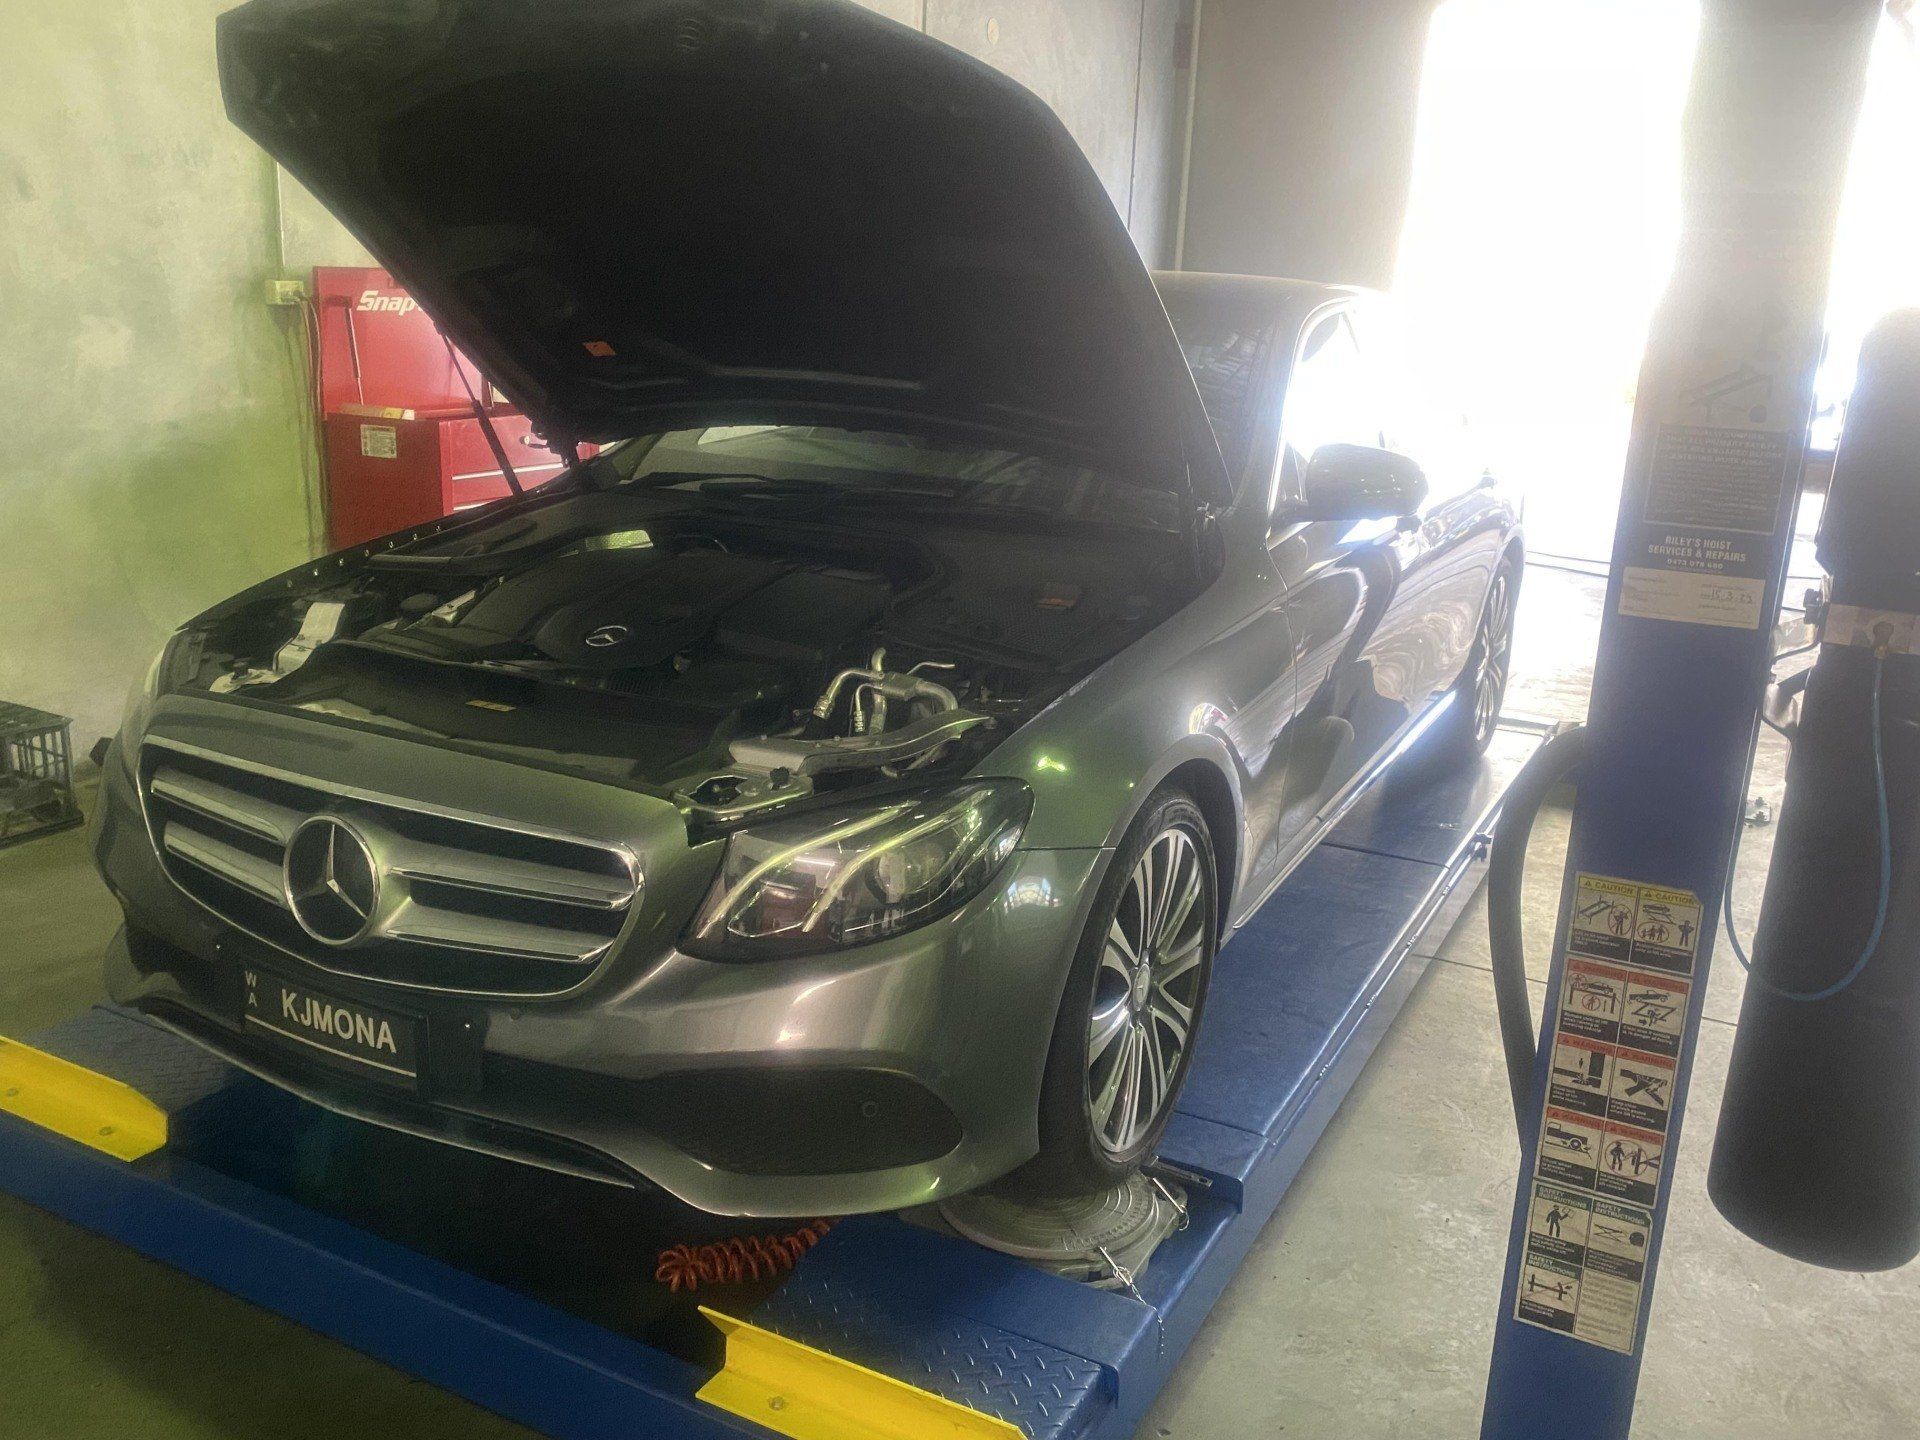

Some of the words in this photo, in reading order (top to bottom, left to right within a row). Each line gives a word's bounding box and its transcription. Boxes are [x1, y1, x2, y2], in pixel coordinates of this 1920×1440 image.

[356, 290, 423, 316] Snap
[1665, 535, 1701, 548] RILEY'S
[1703, 539, 1732, 550] HOIST
[1648, 544, 1692, 557] SERVICES
[1695, 549, 1702, 559] &
[1705, 550, 1747, 562] REPAIRS
[1595, 881, 1634, 895] CAUTION
[1655, 892, 1695, 906] CAUTION
[281, 988, 396, 1053] KJMONA
[1596, 1201, 1621, 1213] SAFETY
